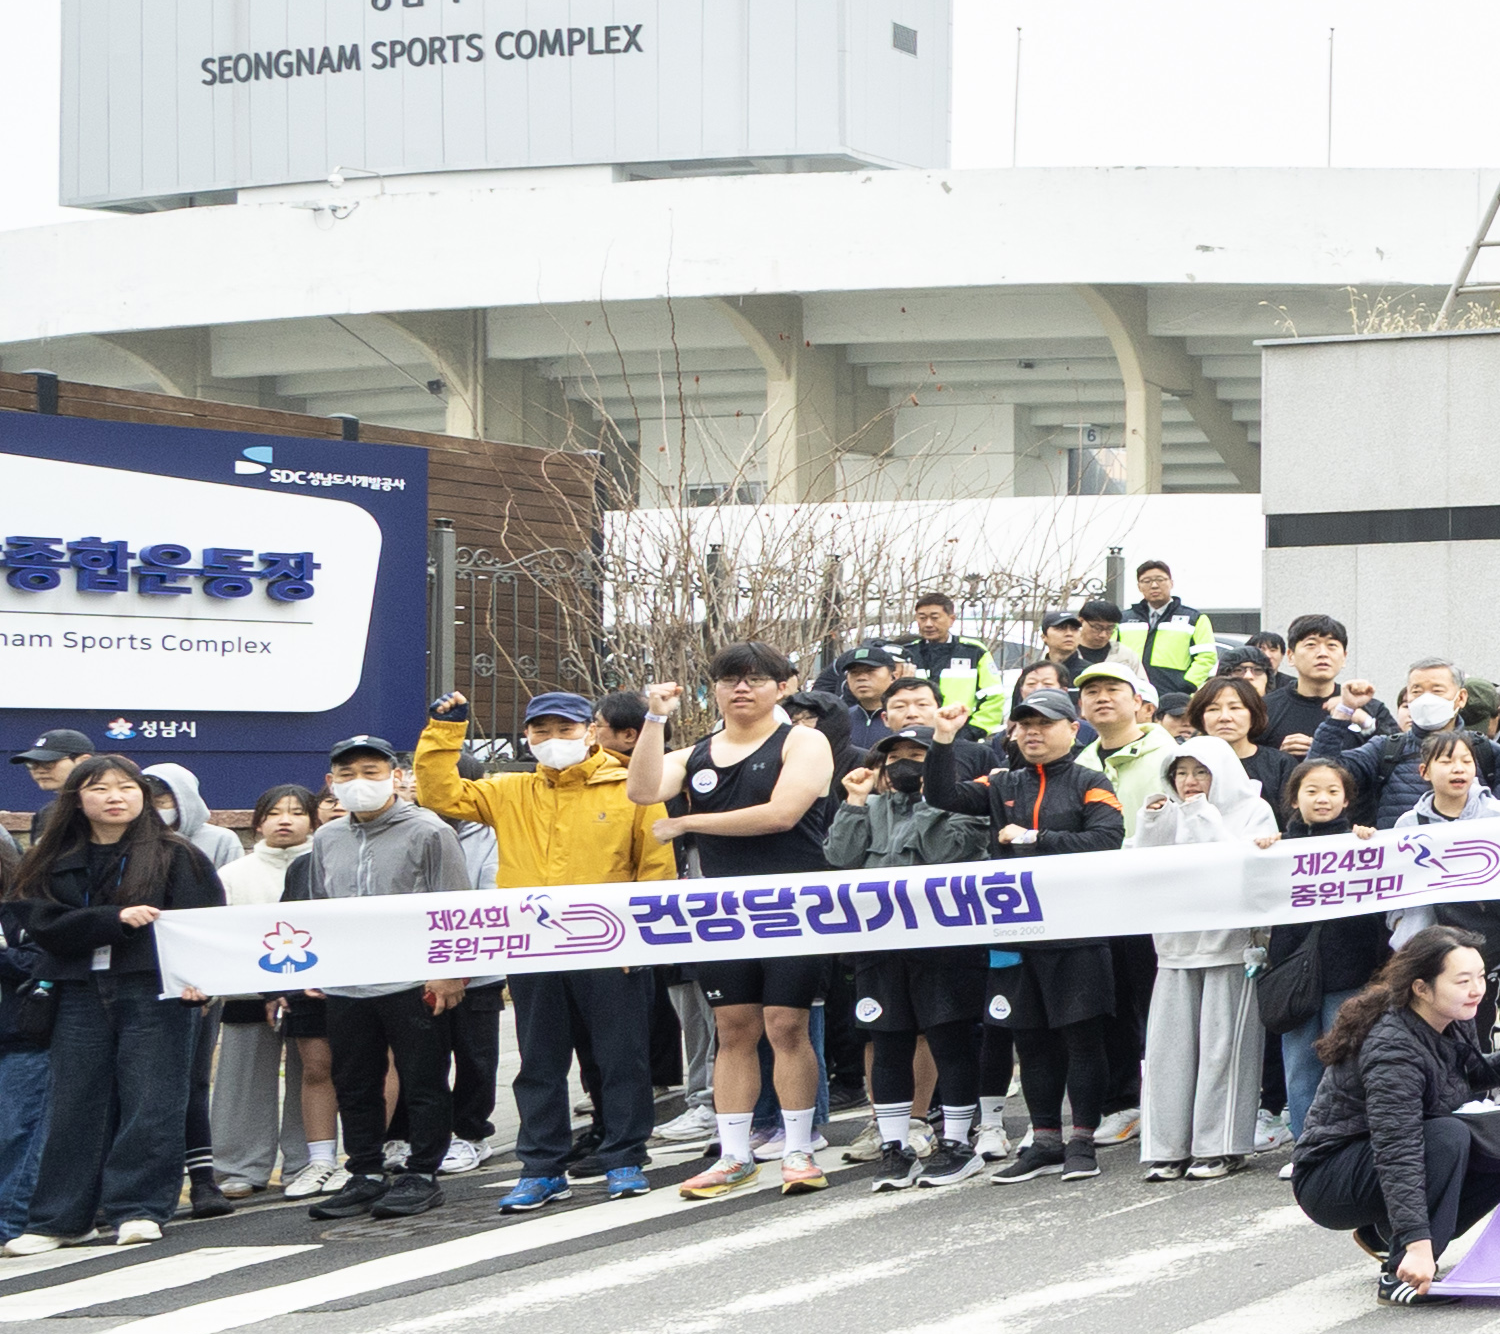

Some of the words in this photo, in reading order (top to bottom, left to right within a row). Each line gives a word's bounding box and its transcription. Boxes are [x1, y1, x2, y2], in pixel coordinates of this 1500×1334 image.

[200, 43, 362, 87] SEONGNAM
[370, 34, 485, 70] SPORTS
[494, 24, 645, 64] COMPLEX
[1086, 428, 1097, 442] 6
[269, 468, 307, 485] SDC
[307, 471, 406, 492] 성남도시개발공사
[0, 535, 322, 603] 종합운동장
[63, 631, 152, 654] Sports
[161, 634, 272, 657] Complex
[138, 720, 197, 739] 성남시
[1291, 847, 1386, 877] 제24회
[1290, 874, 1405, 908] 중원구민
[426, 904, 511, 932] 제24회
[627, 873, 921, 947] 건강달리기
[924, 870, 1045, 929] 대회
[992, 926, 1018, 938] Since
[1019, 925, 1045, 937] 2000
[426, 933, 531, 964] 중원구민
